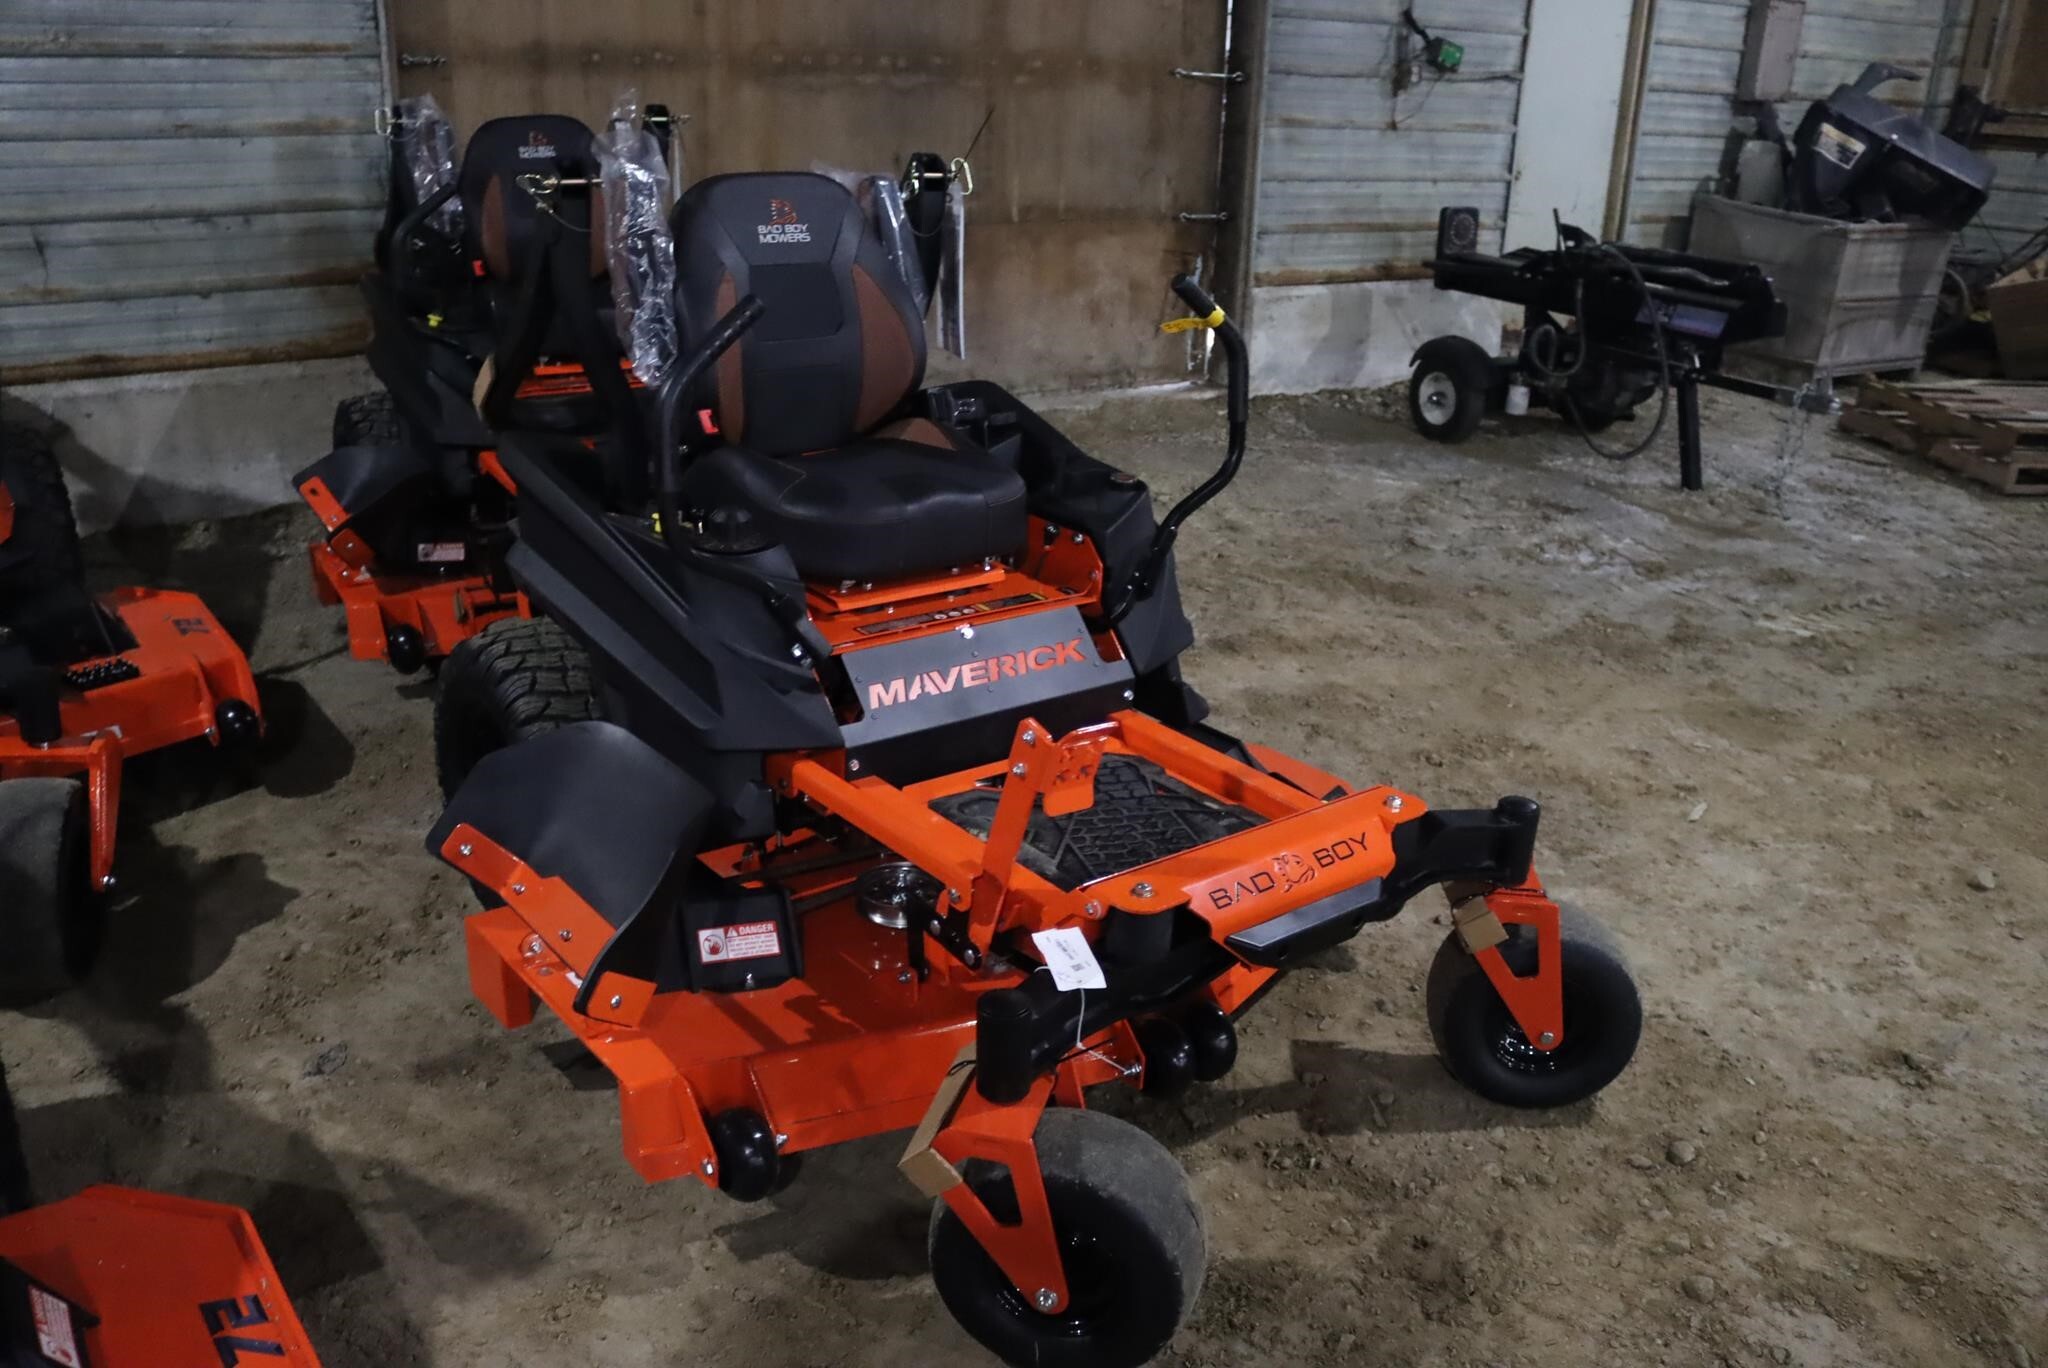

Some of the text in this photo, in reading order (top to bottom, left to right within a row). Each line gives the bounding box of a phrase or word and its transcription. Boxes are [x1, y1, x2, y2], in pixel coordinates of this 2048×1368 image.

[757, 223, 809, 234] BAD BOY
[759, 232, 811, 243] MOWERS
[868, 637, 1086, 710] MAVERICK
[1209, 831, 1368, 910] BAD BOY
[738, 922, 774, 936] DANGER
